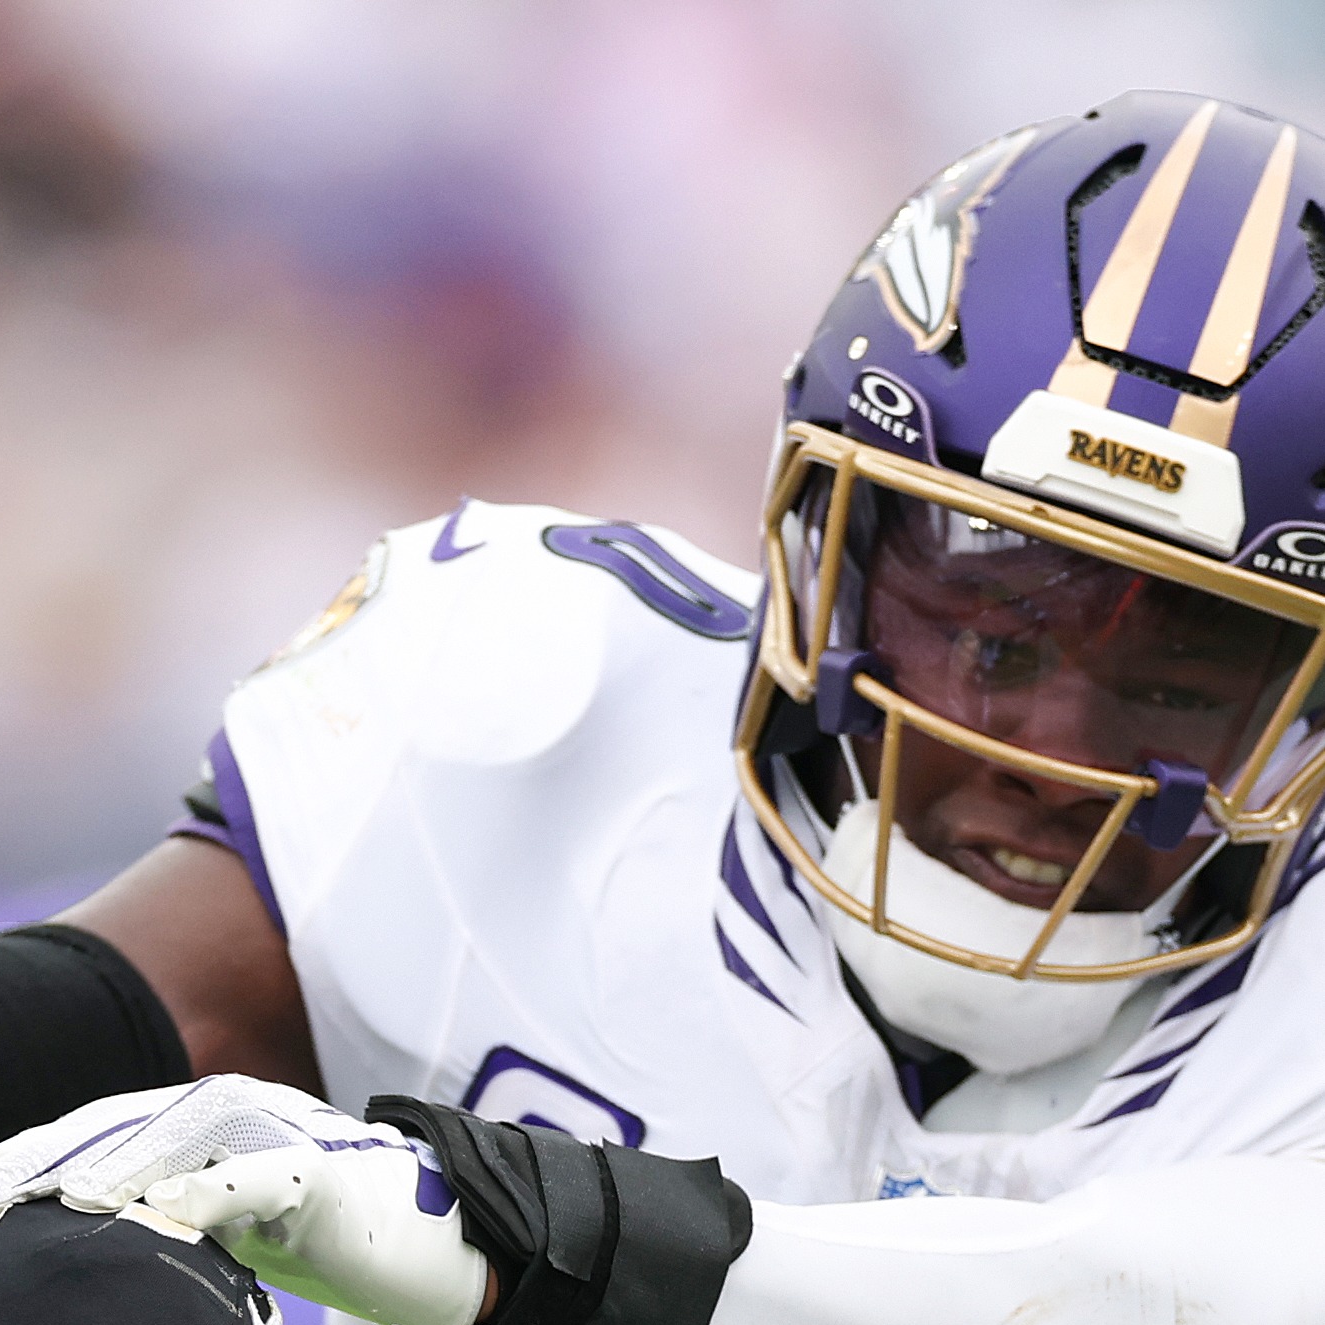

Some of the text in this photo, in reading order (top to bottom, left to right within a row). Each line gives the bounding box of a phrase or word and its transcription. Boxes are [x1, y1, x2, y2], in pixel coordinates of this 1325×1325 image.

[848, 392, 923, 444] OAKLEY
[1067, 429, 1187, 494] RAVENS
[541, 520, 754, 641] 0
